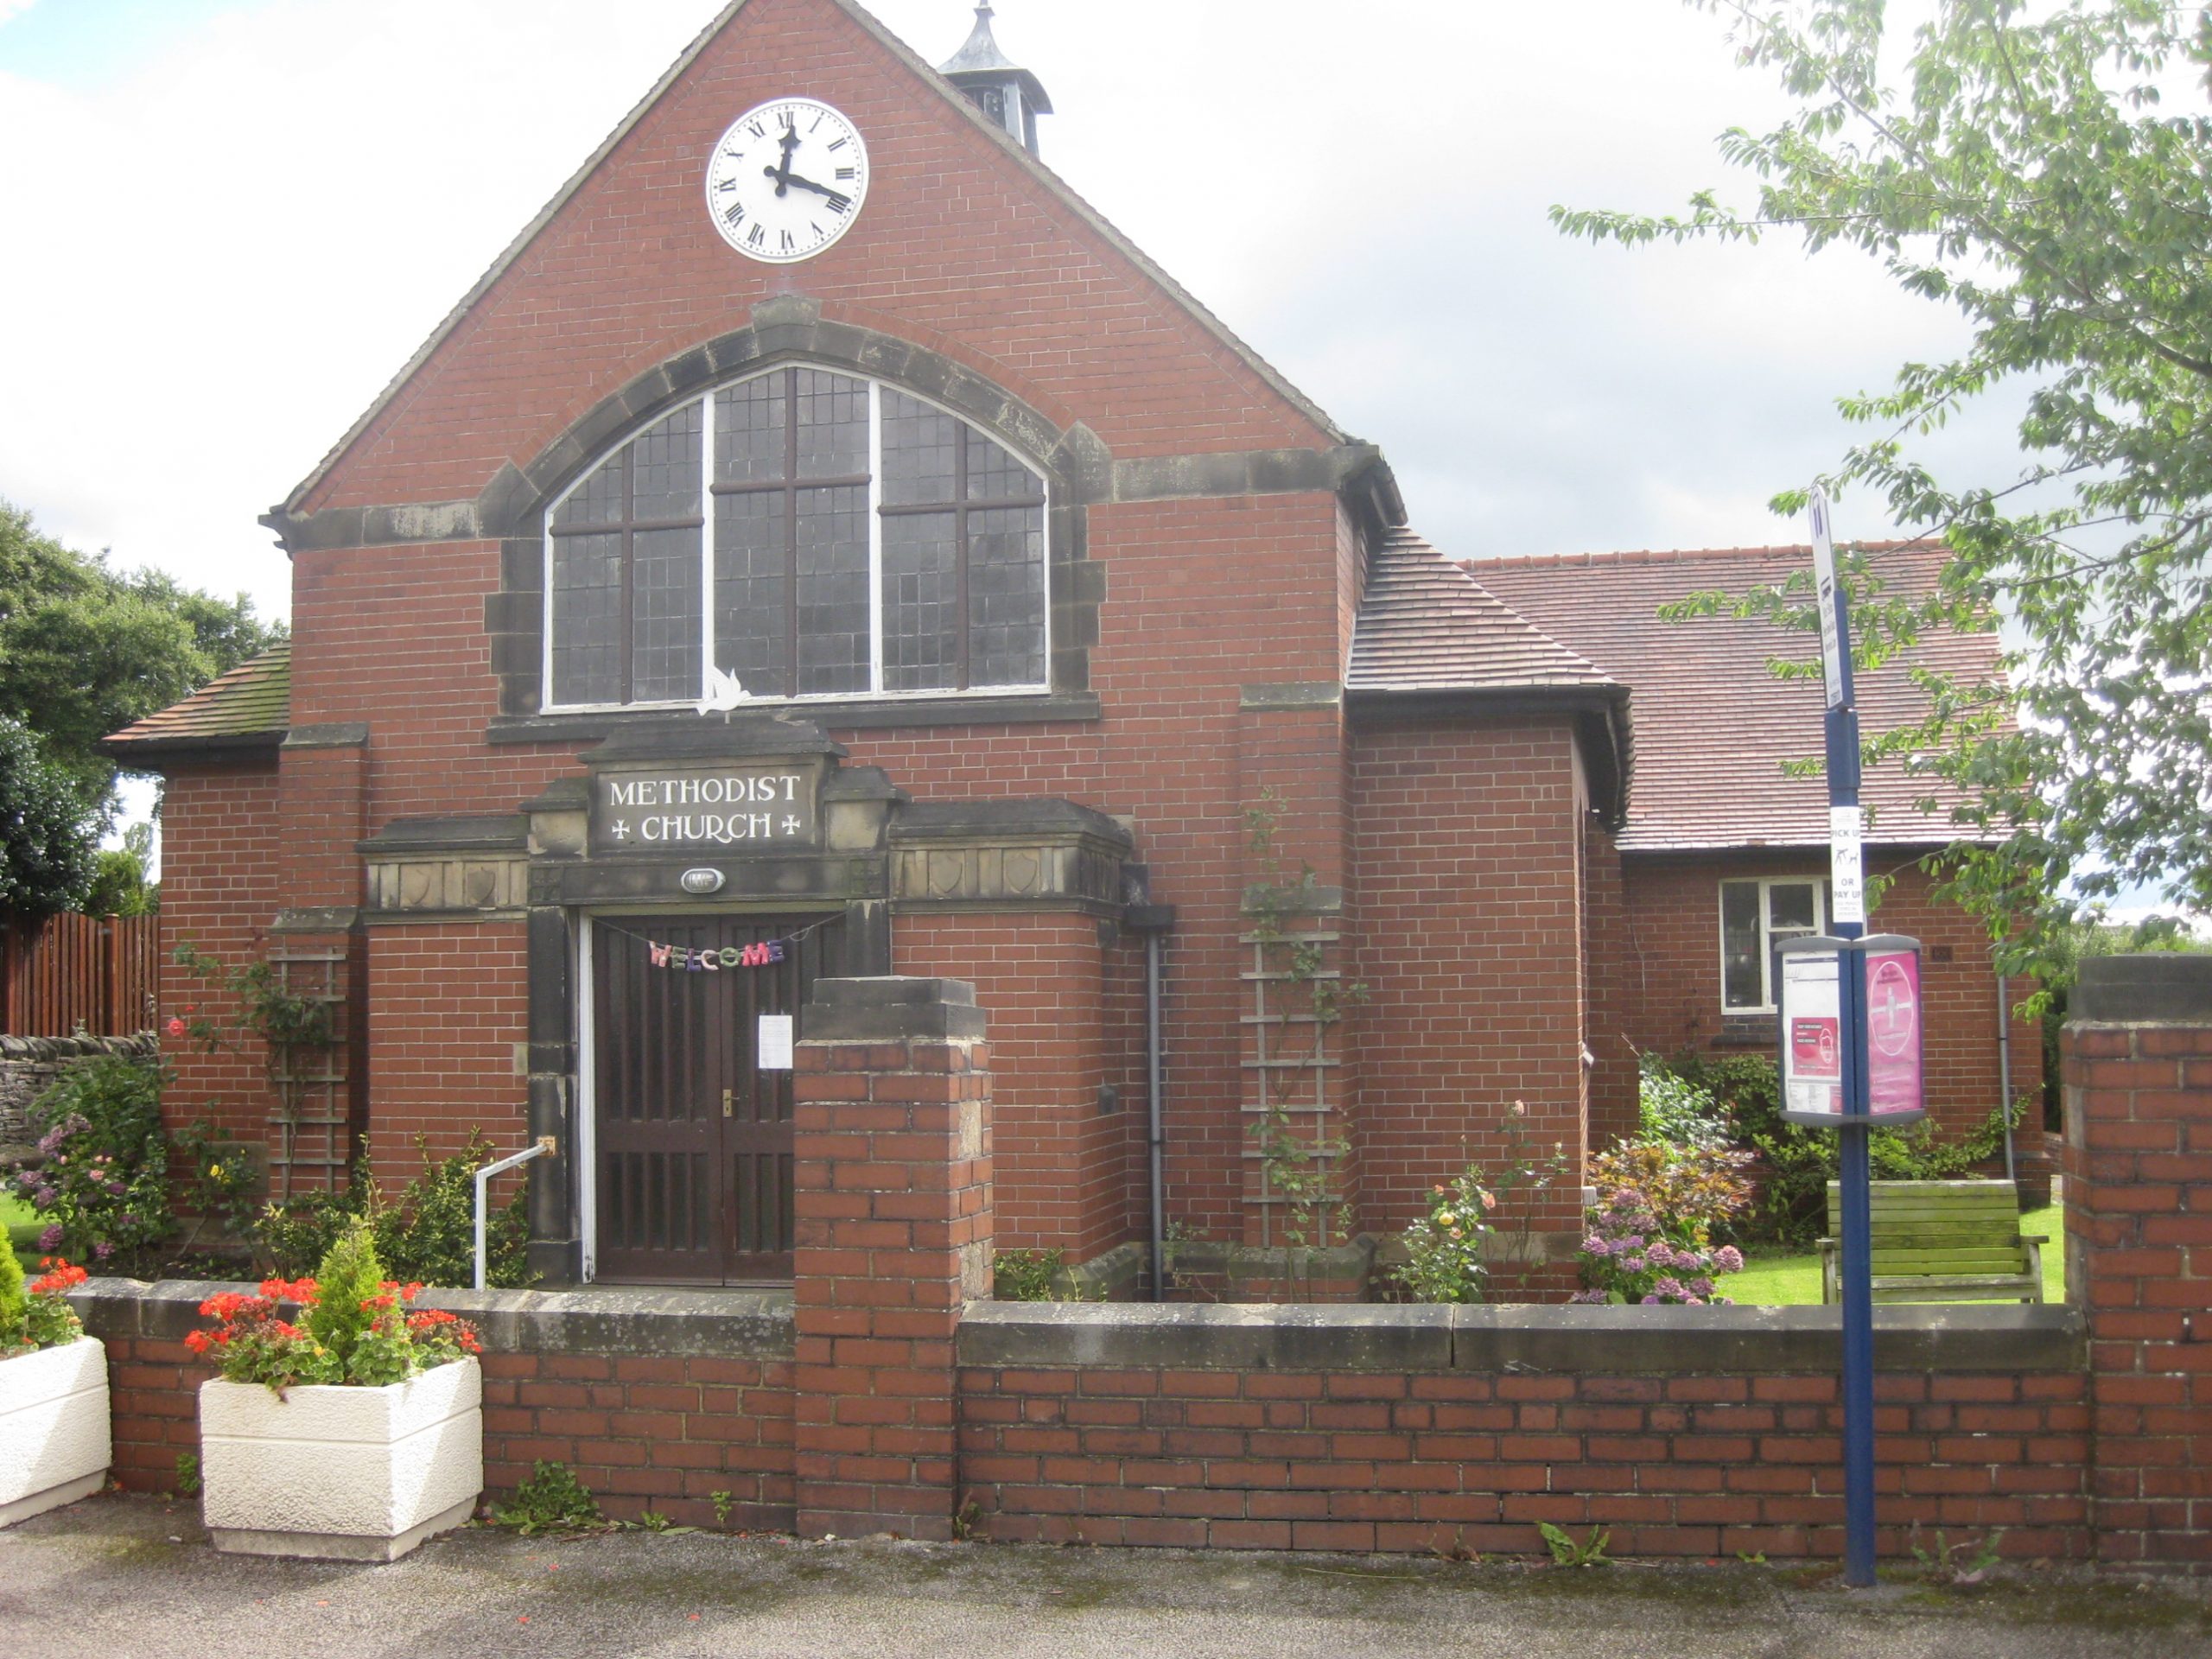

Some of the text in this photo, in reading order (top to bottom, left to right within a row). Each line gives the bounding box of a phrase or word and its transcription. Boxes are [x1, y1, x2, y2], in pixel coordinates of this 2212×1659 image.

[775, 111, 794, 130] XII
[748, 121, 766, 143] XI
[827, 137, 847, 152] II
[727, 148, 744, 162] X
[836, 168, 855, 180] III
[719, 177, 736, 193] IX
[725, 201, 747, 228] VIII
[825, 196, 849, 215] III
[747, 222, 766, 246] VII
[780, 229, 795, 249] VI
[810, 220, 824, 239] V
[610, 775, 801, 806] METHODIST
[641, 812, 772, 844] CHURCH
[1840, 878, 1854, 887] OR
[1834, 891, 1861, 899] PAY UP
[649, 939, 785, 972] WELCOME
